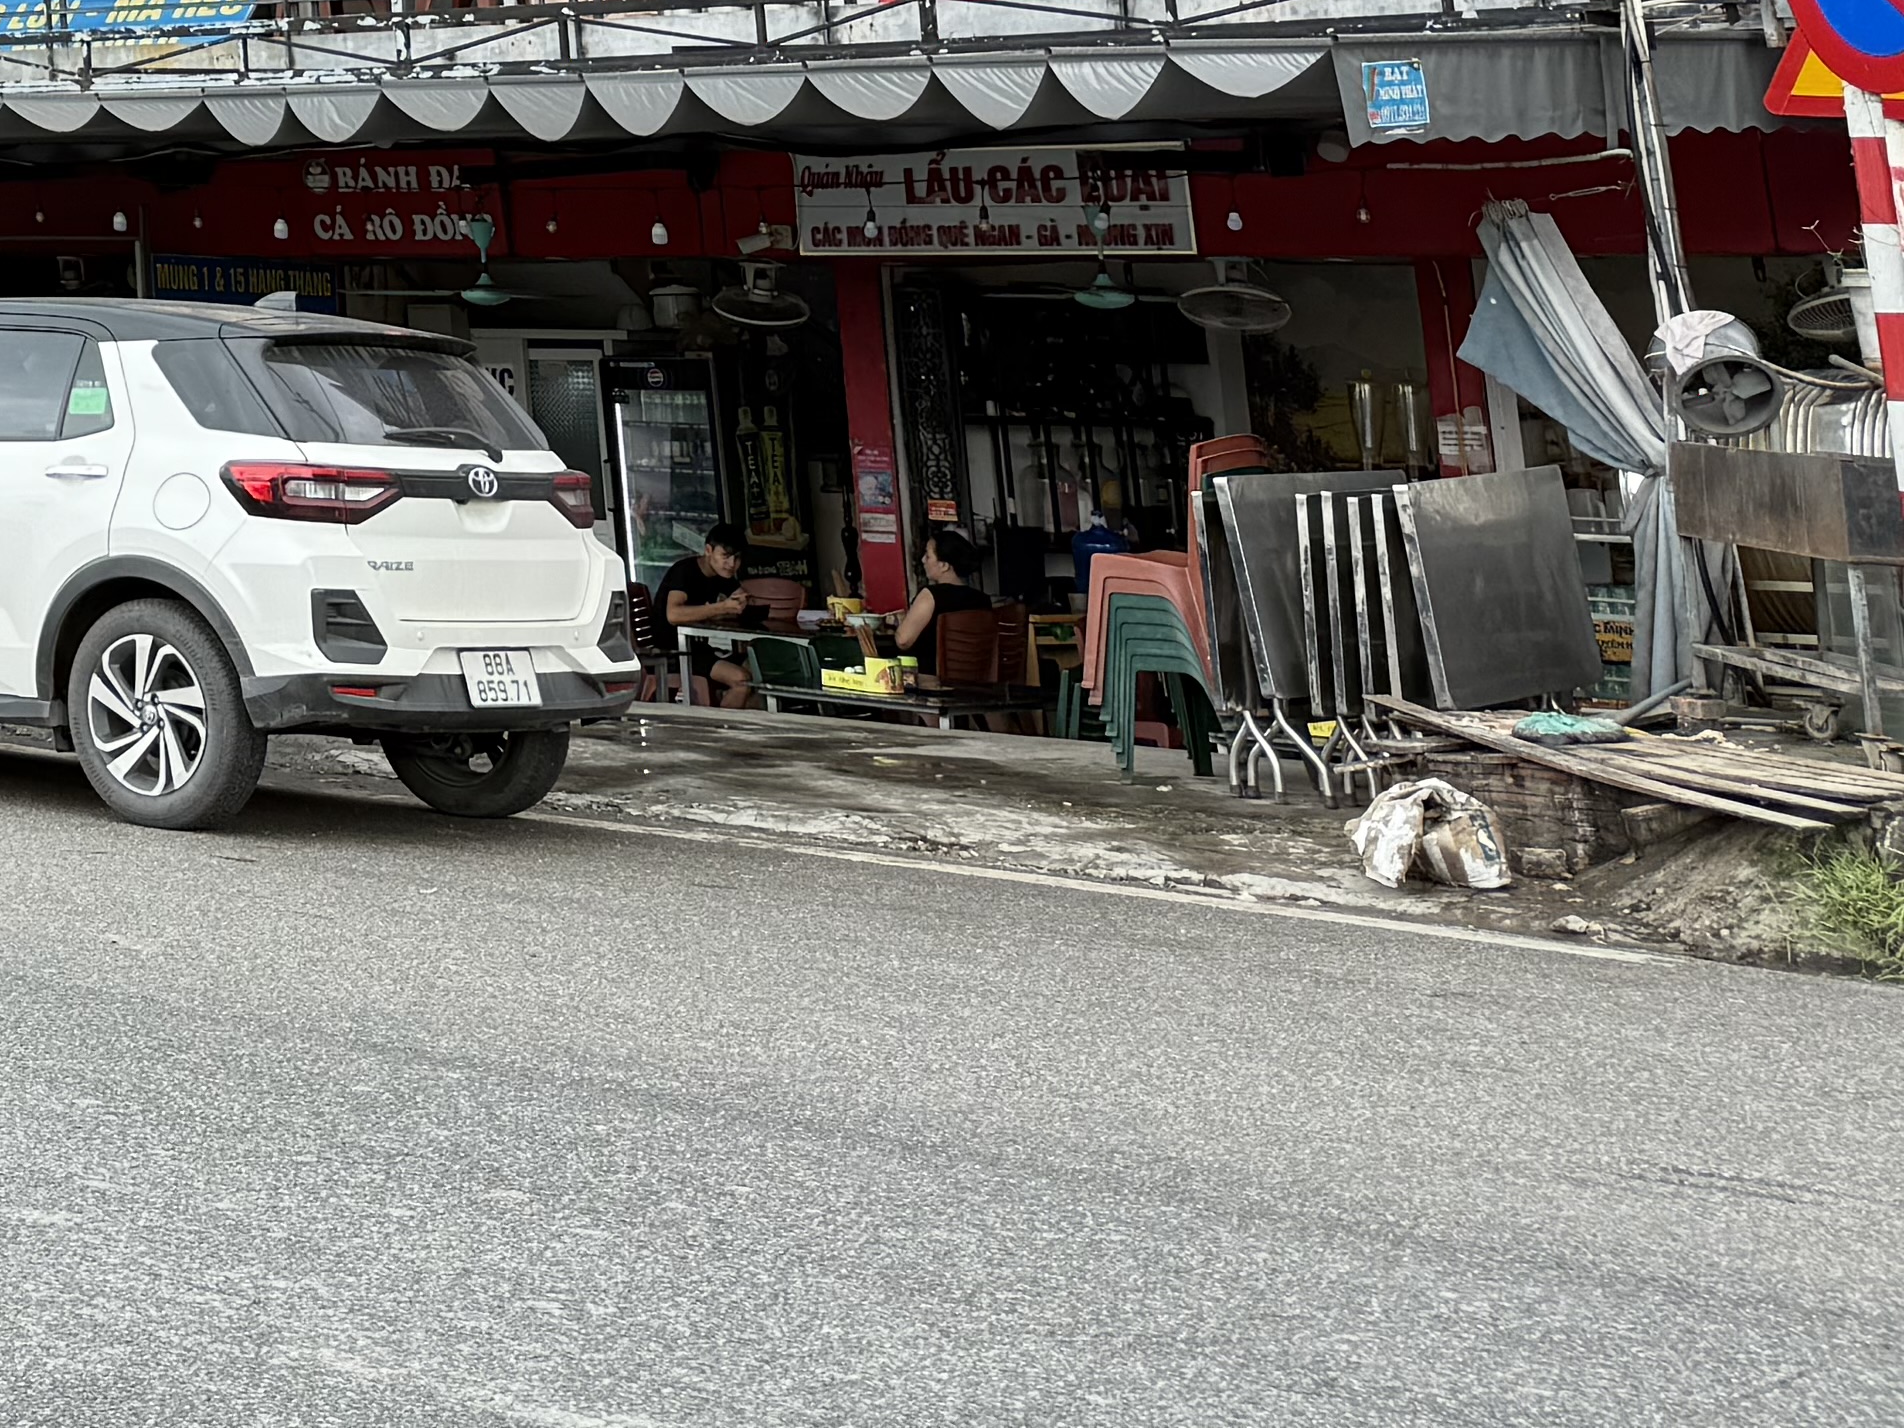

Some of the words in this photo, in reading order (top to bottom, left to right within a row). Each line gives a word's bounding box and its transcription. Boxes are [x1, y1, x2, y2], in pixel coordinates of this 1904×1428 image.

[335, 157, 419, 192] BÁNH
[801, 163, 840, 197] Quán
[903, 151, 973, 204] LẨU
[988, 157, 1066, 204] CÁC
[314, 205, 354, 240] CÁ
[811, 222, 843, 247] CÁC
[1038, 218, 1060, 246] GÀ
[156, 259, 199, 290] MÙNG
[202, 266, 209, 291] 1
[214, 266, 225, 292] &
[229, 267, 246, 293] 15
[249, 263, 285, 294] HÀNG
[287, 266, 333, 296] THÁNG
[483, 653, 515, 675] 88A
[477, 680, 531, 702] 859.71
